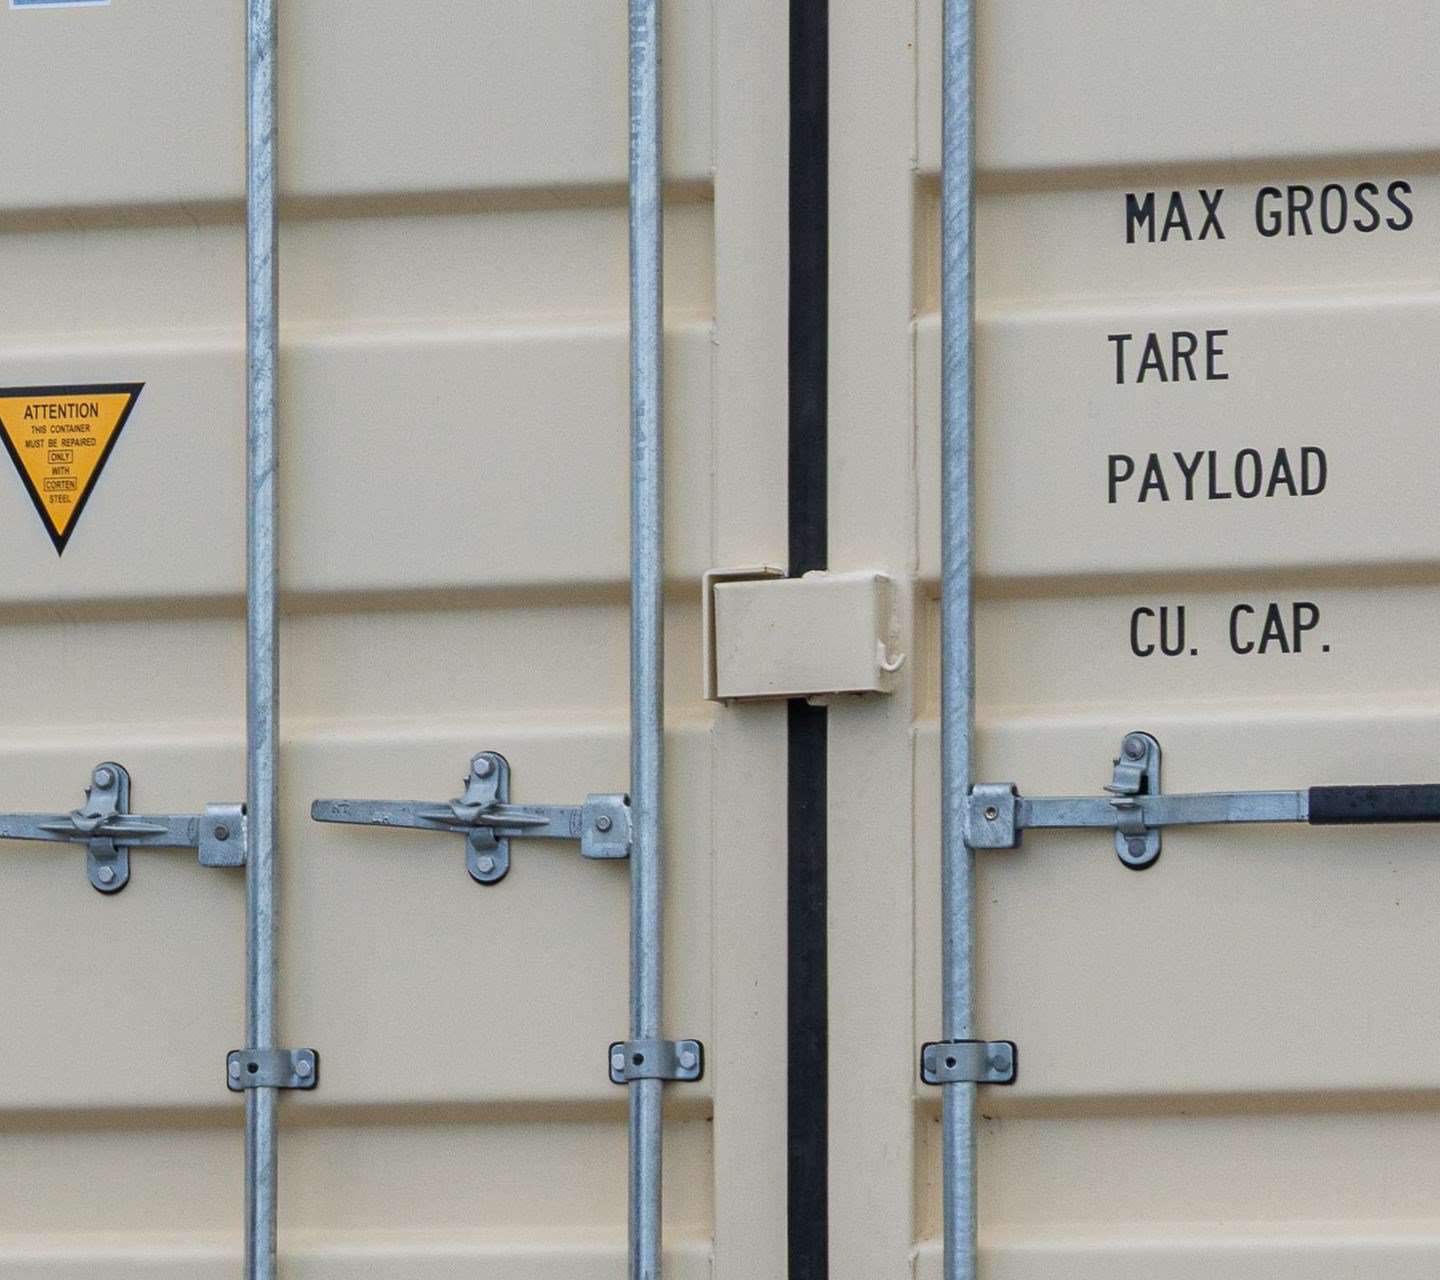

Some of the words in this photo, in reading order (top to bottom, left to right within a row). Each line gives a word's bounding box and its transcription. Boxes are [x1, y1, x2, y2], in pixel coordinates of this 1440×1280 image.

[1125, 189, 1226, 244] MAX
[1255, 180, 1414, 236] GROSS
[1107, 329, 1229, 384] TARE
[24, 402, 99, 420] ATTENTION
[31, 425, 47, 434] THIS
[50, 424, 91, 434] CONTAINER
[25, 439, 44, 449] MUST
[48, 439, 58, 448] BE
[61, 438, 96, 447] REPAIRED
[51, 452, 70, 461] ONLY
[52, 466, 69, 475] WITH
[1107, 446, 1328, 503] PAYLOAD
[46, 480, 75, 489] CORTEN
[49, 494, 71, 503] STEEL
[1130, 605, 1198, 657] CU.
[1229, 601, 1330, 654] CAP.
